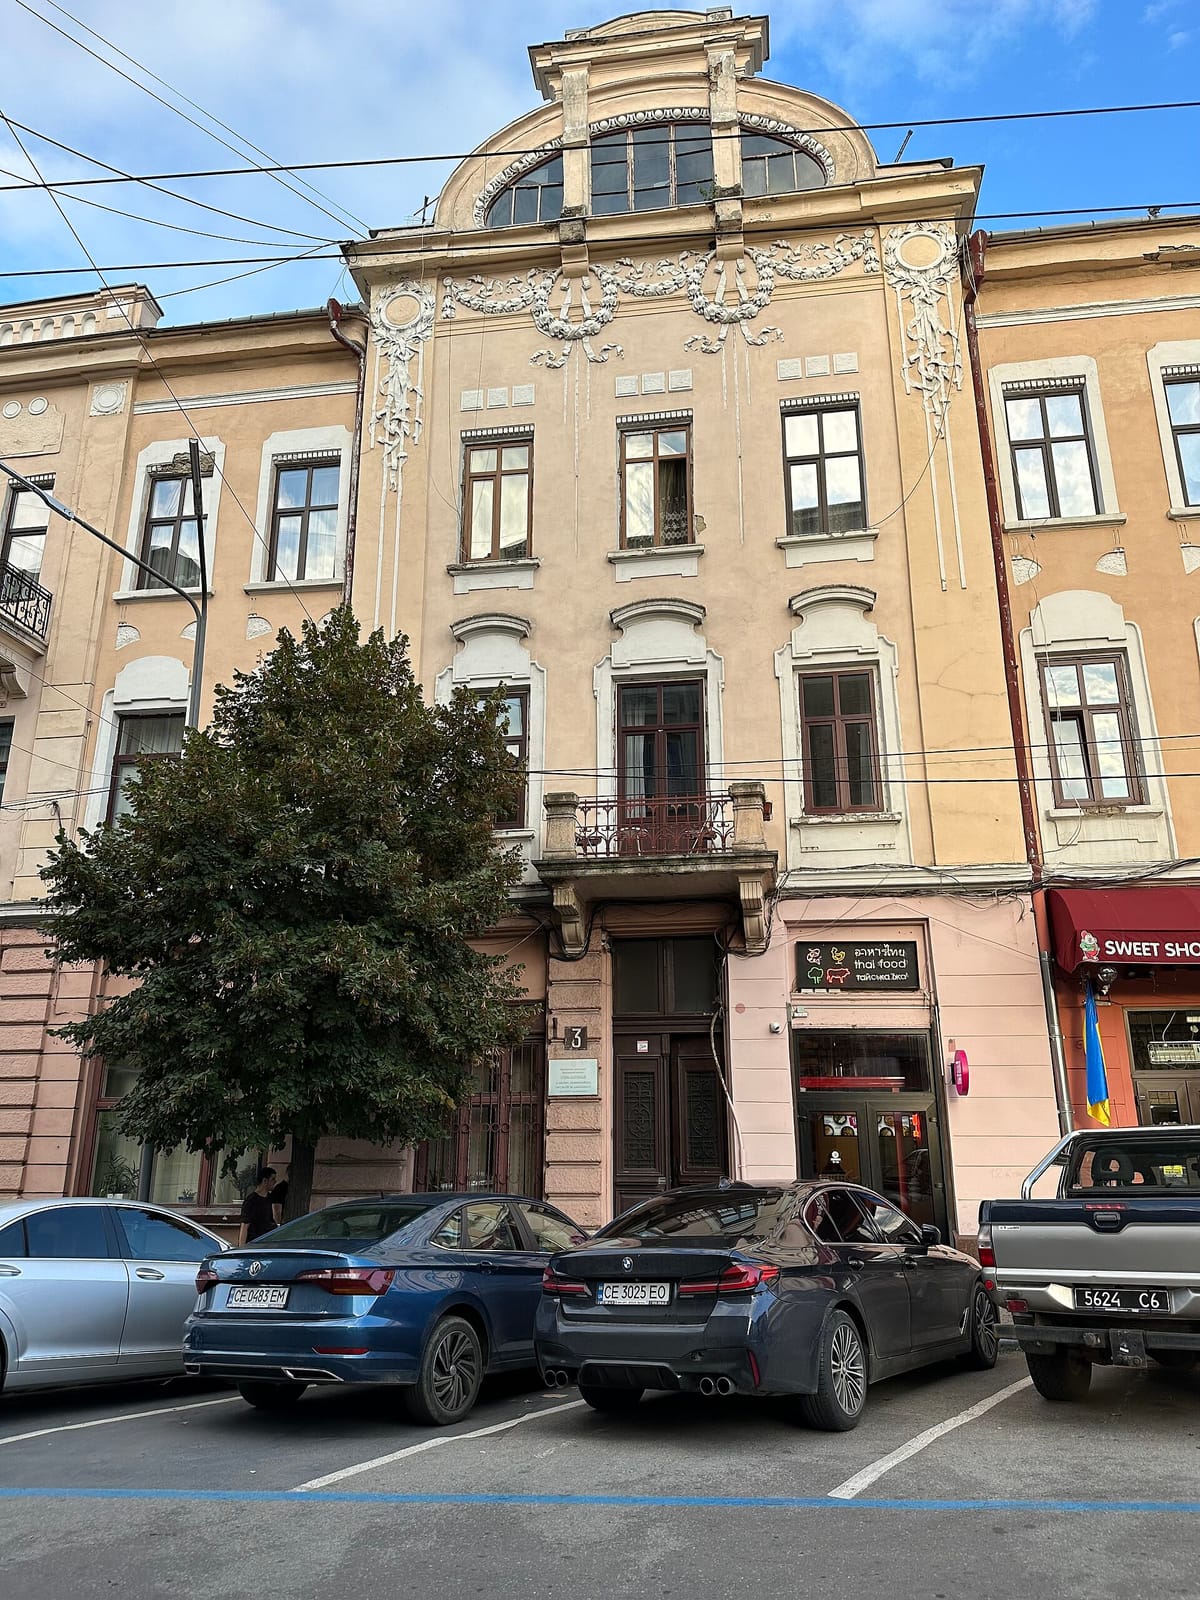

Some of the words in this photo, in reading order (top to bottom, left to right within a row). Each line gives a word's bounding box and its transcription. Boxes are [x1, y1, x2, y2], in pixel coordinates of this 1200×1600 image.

[1104, 940, 1160, 957] SWEET
[1164, 942, 1200, 957] SHO
[854, 959, 876, 970] thai
[878, 958, 907, 969] food
[571, 1027, 582, 1048] 3
[234, 1289, 248, 1303] CE
[247, 1289, 270, 1303] 0483
[270, 1289, 286, 1303] EM
[604, 1285, 620, 1299] CE
[621, 1285, 647, 1299] 3025
[649, 1285, 666, 1299] EO
[1084, 1291, 1121, 1307] 5624
[1138, 1292, 1160, 1308] C6
